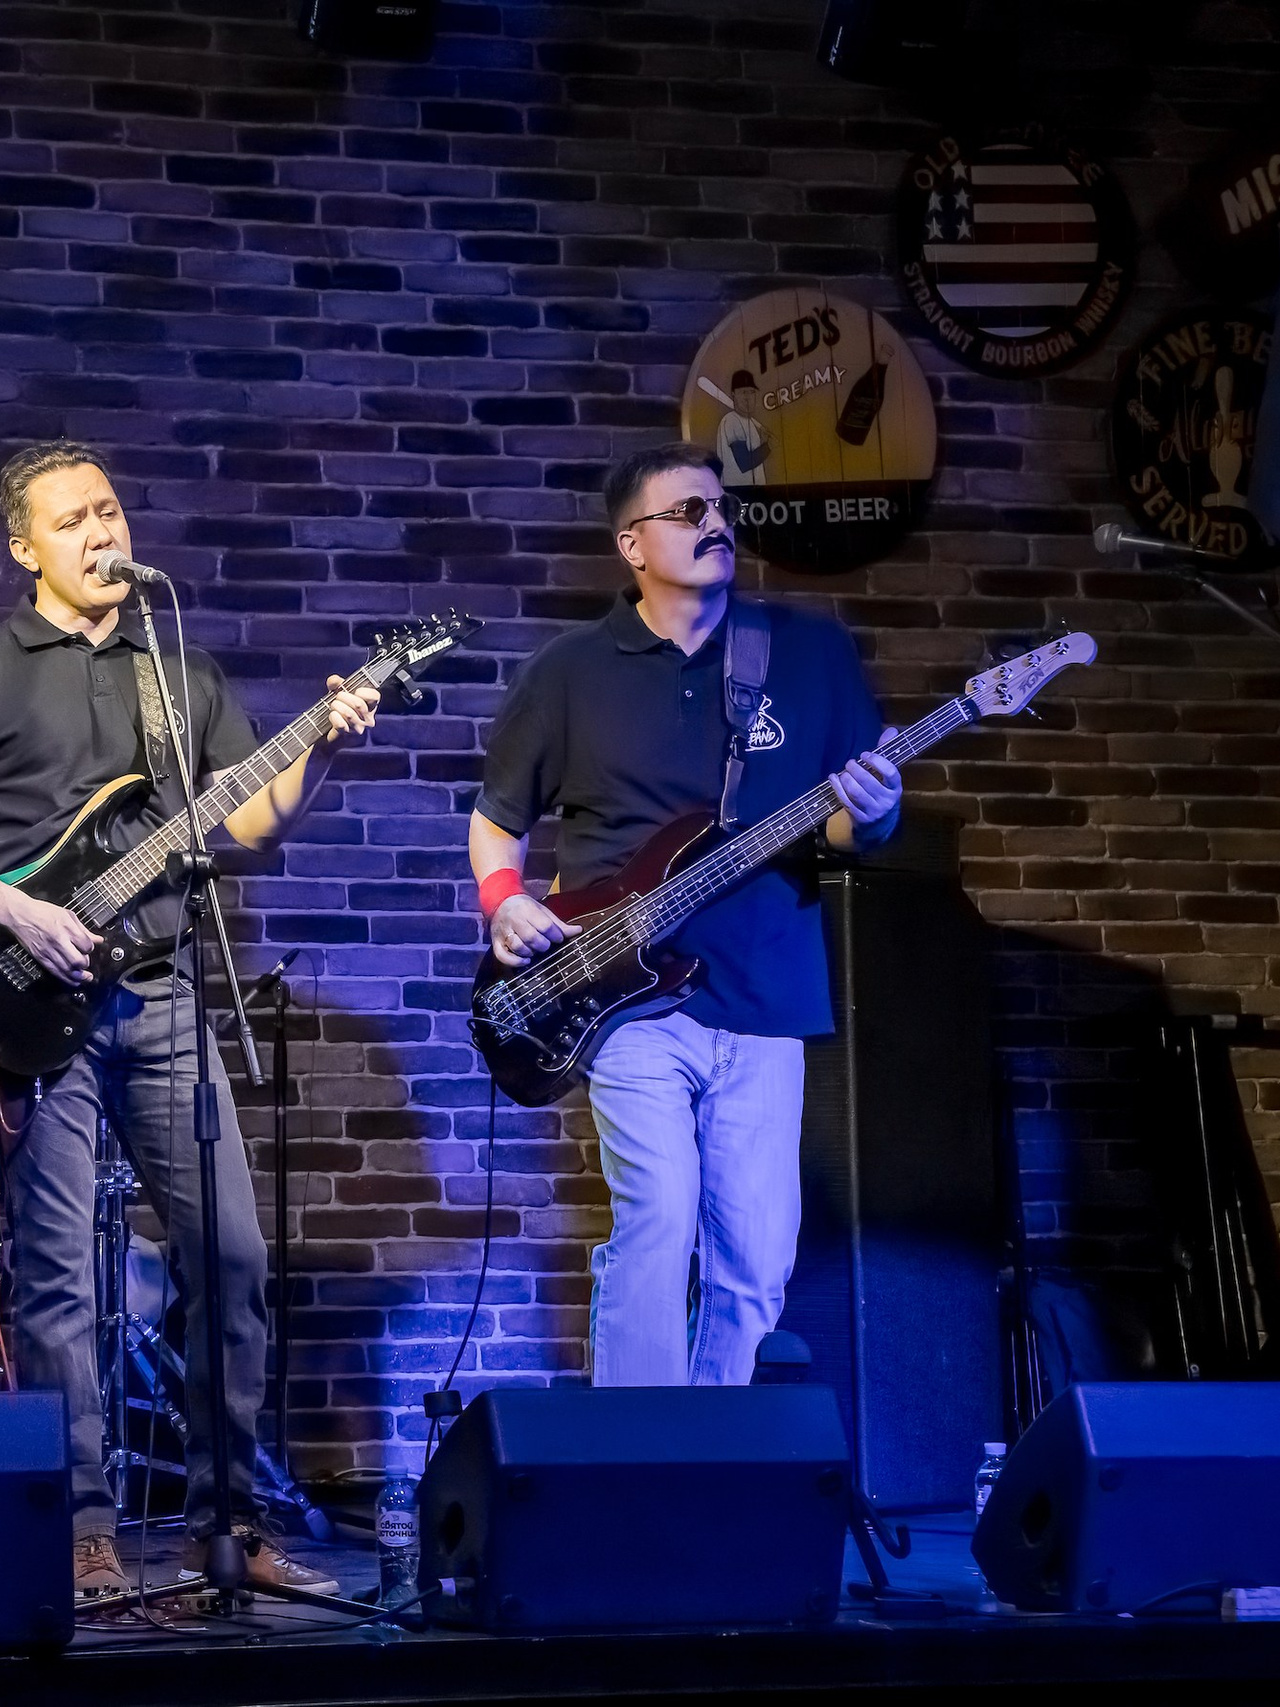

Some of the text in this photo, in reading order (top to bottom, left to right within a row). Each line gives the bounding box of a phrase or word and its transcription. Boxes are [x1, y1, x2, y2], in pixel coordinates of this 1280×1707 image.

[913, 136, 962, 190] OLD
[748, 307, 842, 374] TED'S
[903, 260, 1125, 368] STRAIGHT BOURBON WHISKY
[1136, 320, 1274, 392] FINE BE
[762, 364, 847, 411] CREAMY
[825, 497, 891, 523] BEER
[1129, 465, 1249, 557] SERVED
[406, 636, 453, 665] Ibanez
[748, 731, 776, 746] BAND
